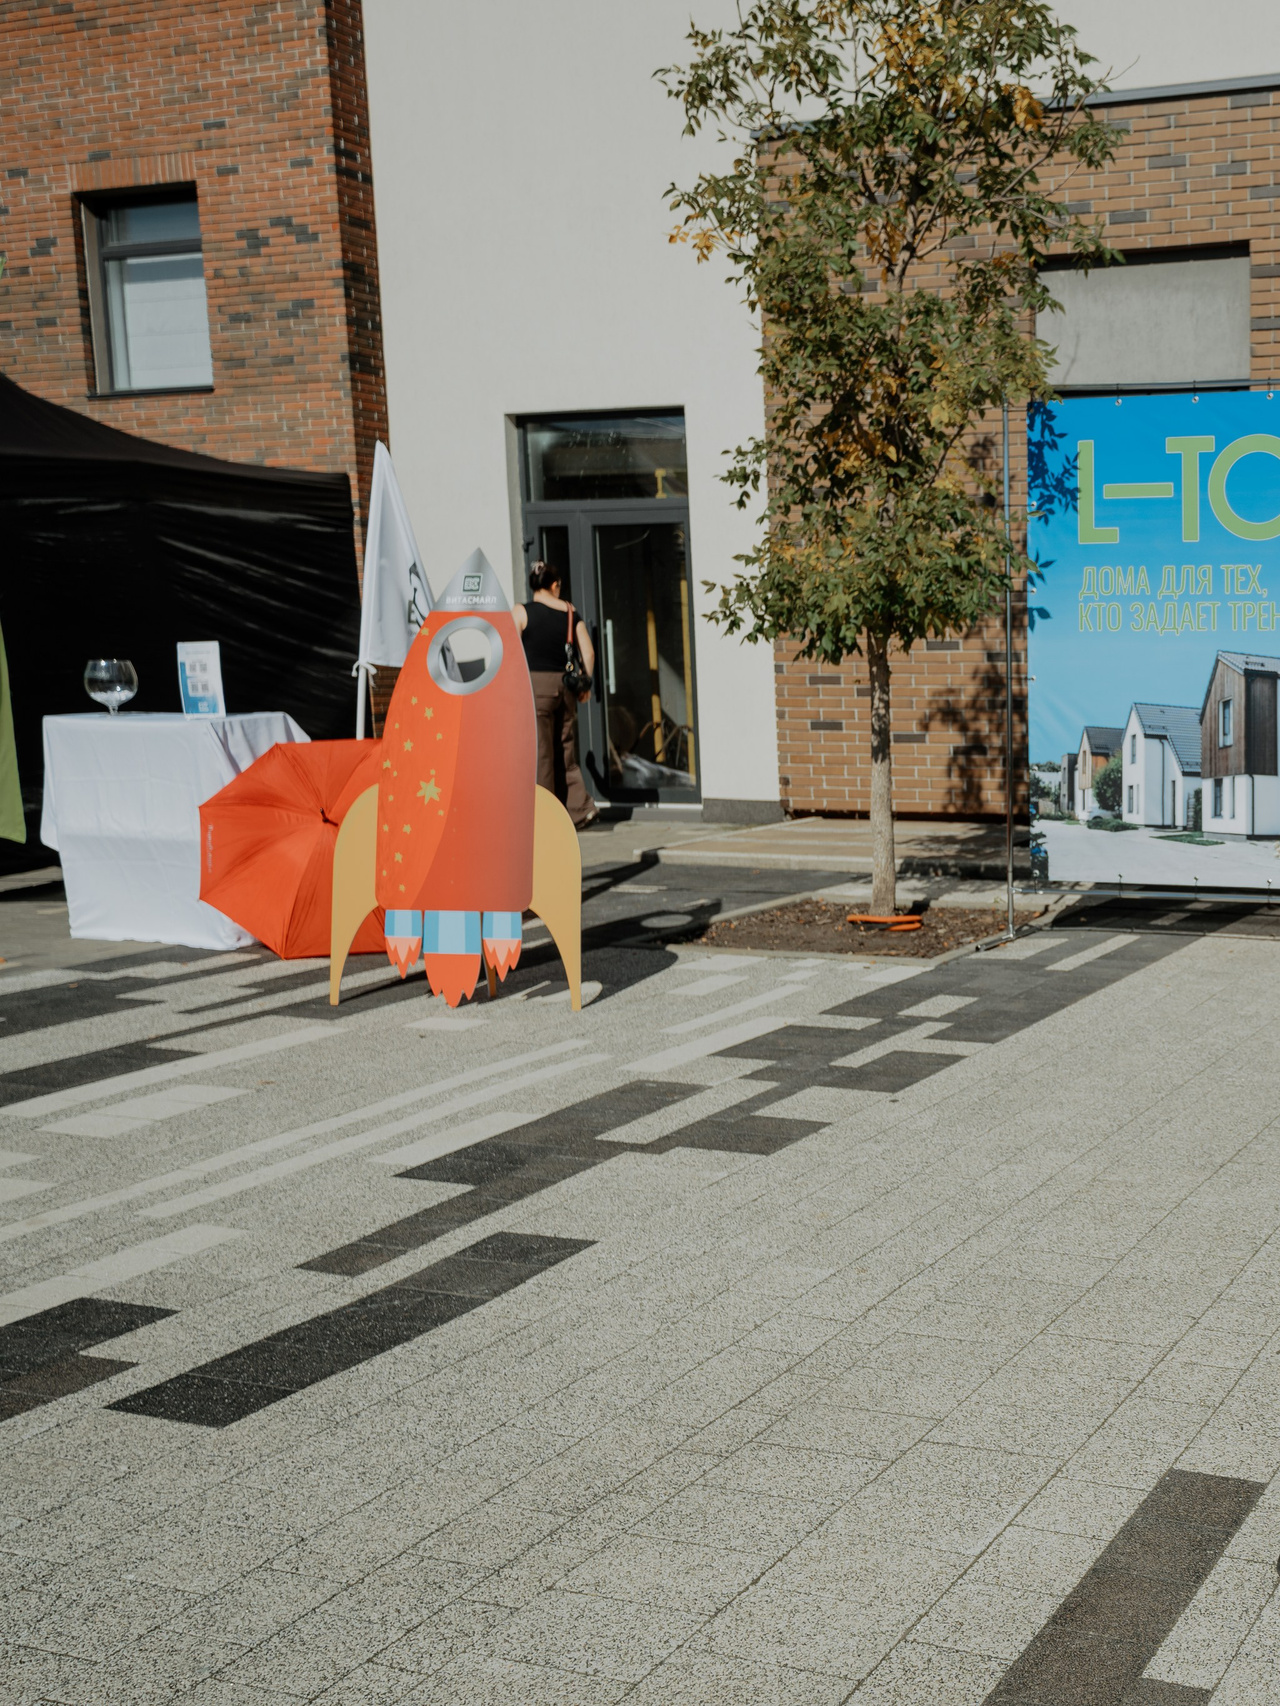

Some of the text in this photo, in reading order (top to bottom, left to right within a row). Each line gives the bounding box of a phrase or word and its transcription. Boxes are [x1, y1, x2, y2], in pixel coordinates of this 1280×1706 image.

[1079, 563, 1268, 599] ДОМА ДЛЯ ТЕХ,
[1078, 602, 1122, 632] КТО
[1130, 601, 1220, 636] ЗАДАЕТ
